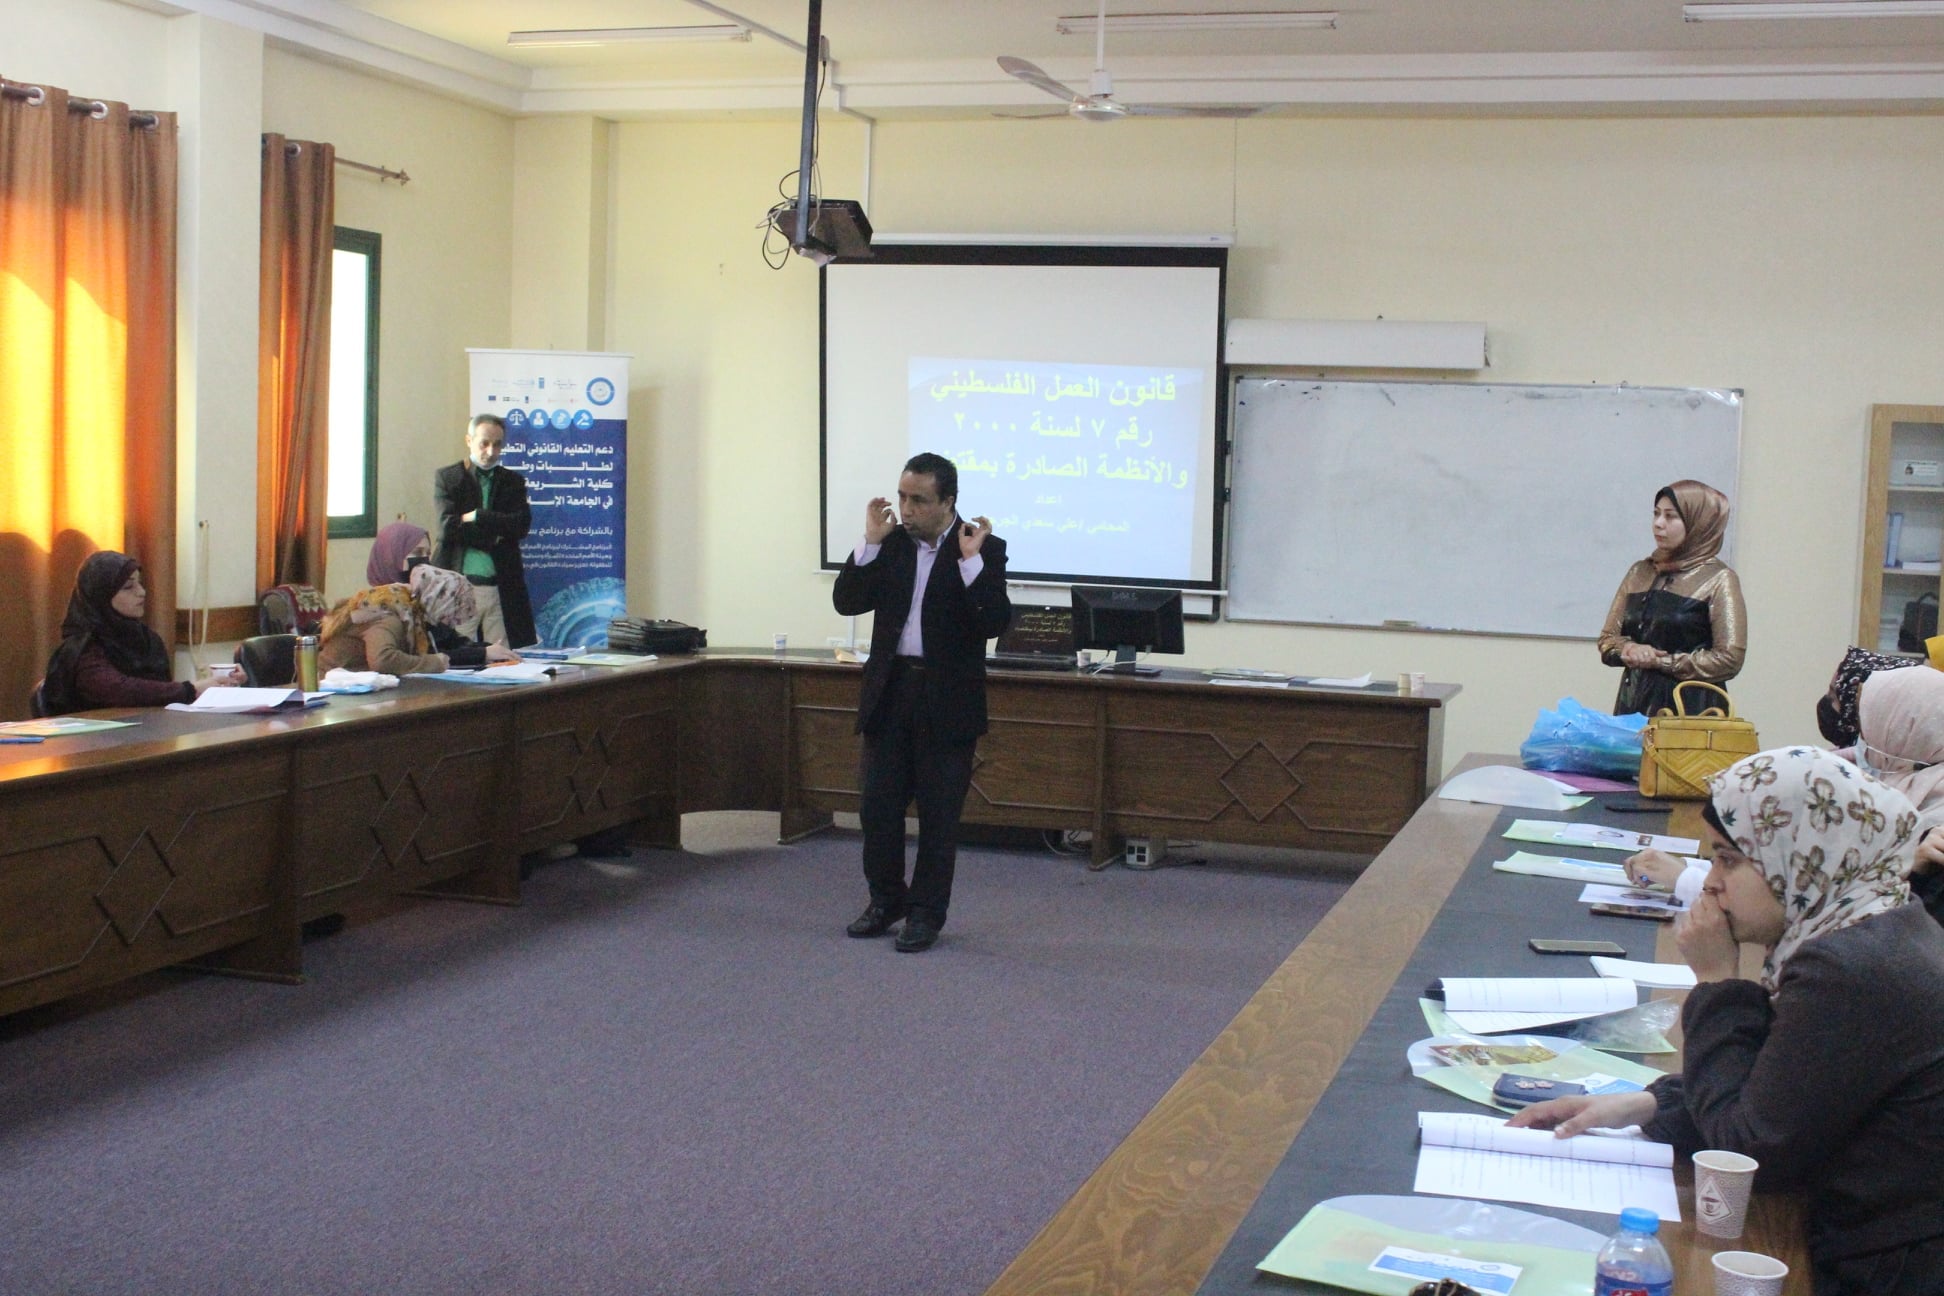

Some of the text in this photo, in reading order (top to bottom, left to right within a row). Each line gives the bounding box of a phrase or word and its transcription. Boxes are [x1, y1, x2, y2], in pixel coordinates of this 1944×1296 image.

[930, 370, 1176, 407] قانون العمل الفلسطيني
[1029, 410, 1081, 437] لسنة
[1091, 417, 1105, 438] ٧
[1115, 416, 1153, 449] رقم
[499, 442, 614, 457] دعم التعليم القانوني التطبي
[1005, 451, 1088, 481] الصادرة
[524, 476, 614, 492] كلية الشريعة
[566, 495, 601, 508] الجامعة
[602, 495, 614, 510] في
[538, 526, 564, 537] برنامج
[565, 527, 577, 537] مع
[577, 526, 614, 537] بالشراكة
